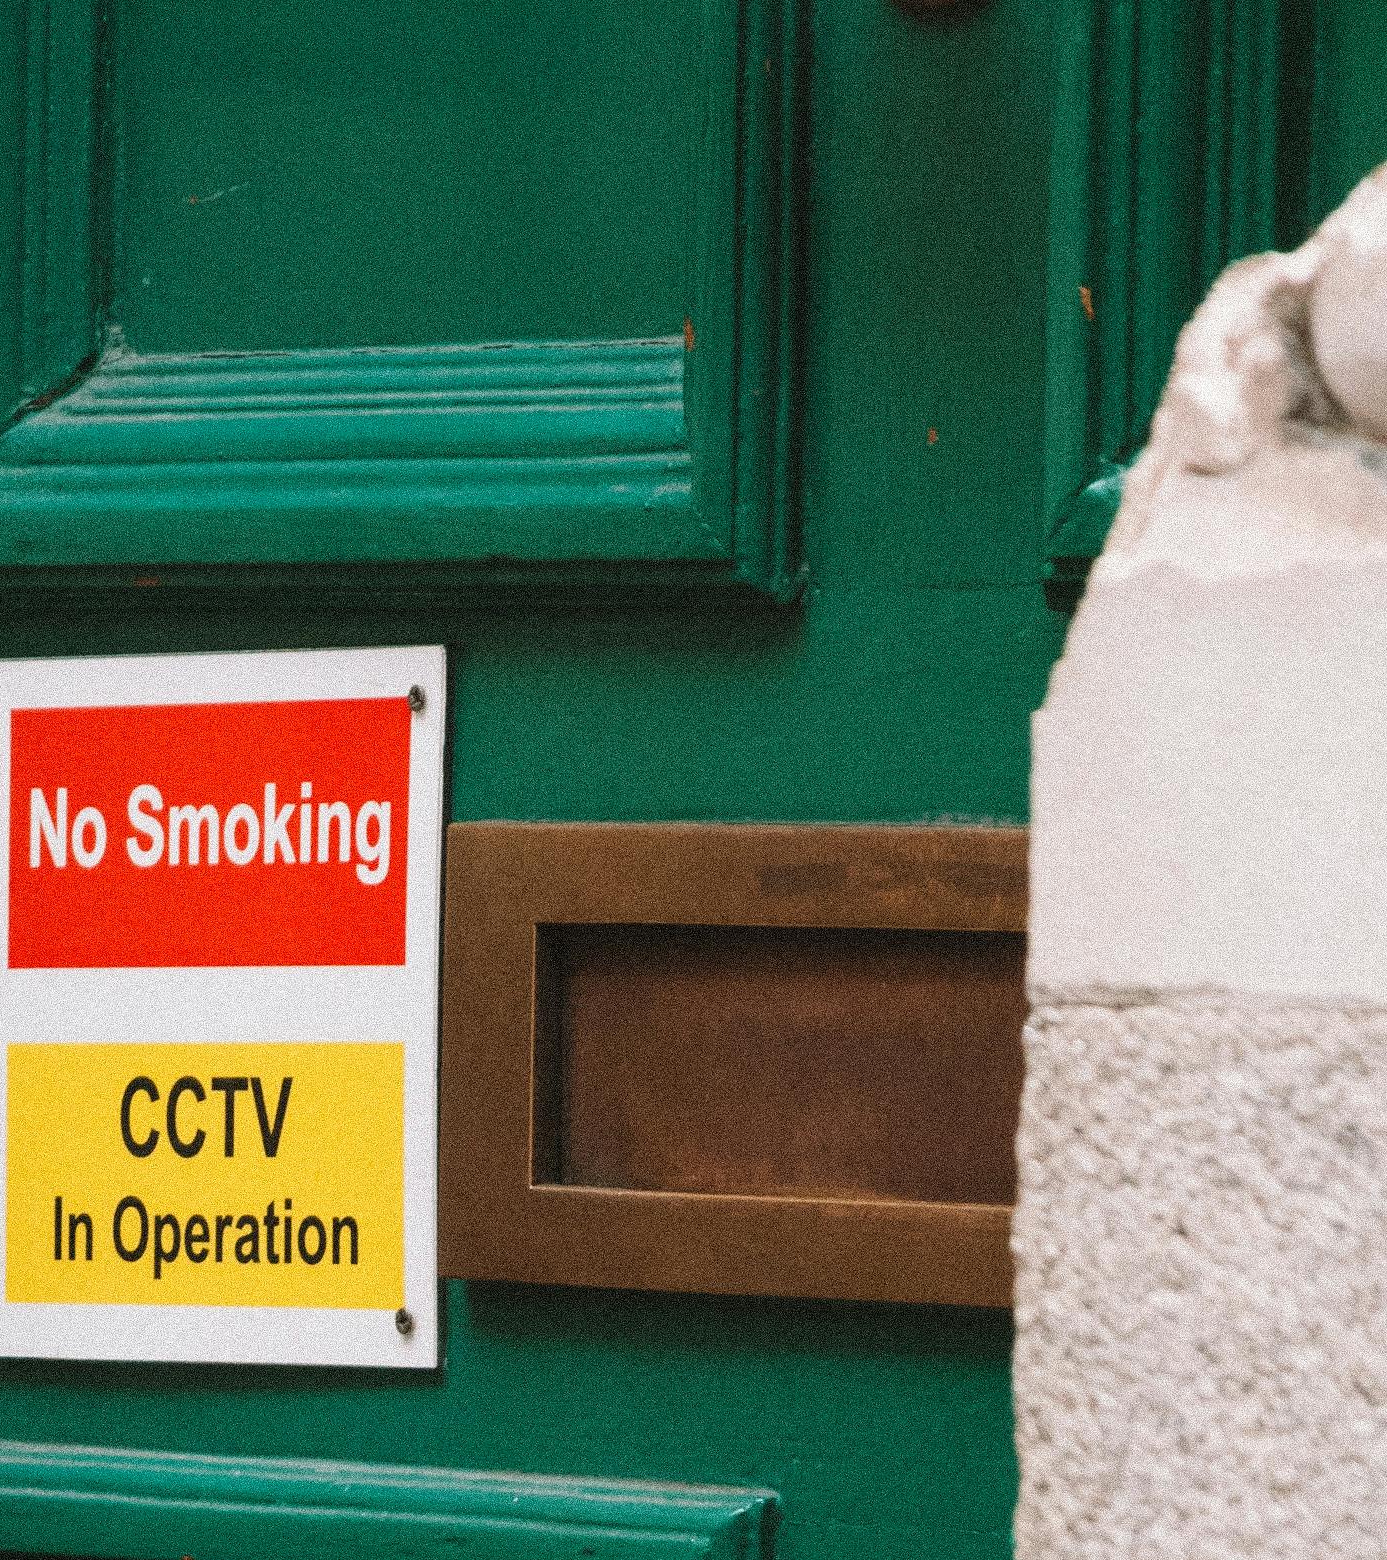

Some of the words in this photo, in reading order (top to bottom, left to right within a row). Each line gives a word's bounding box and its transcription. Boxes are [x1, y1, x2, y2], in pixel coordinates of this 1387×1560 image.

[28, 785, 108, 869] No
[125, 782, 392, 886] Smoking
[119, 1075, 294, 1159] CCTV
[53, 1194, 94, 1262] In
[112, 1193, 360, 1280] Operation
